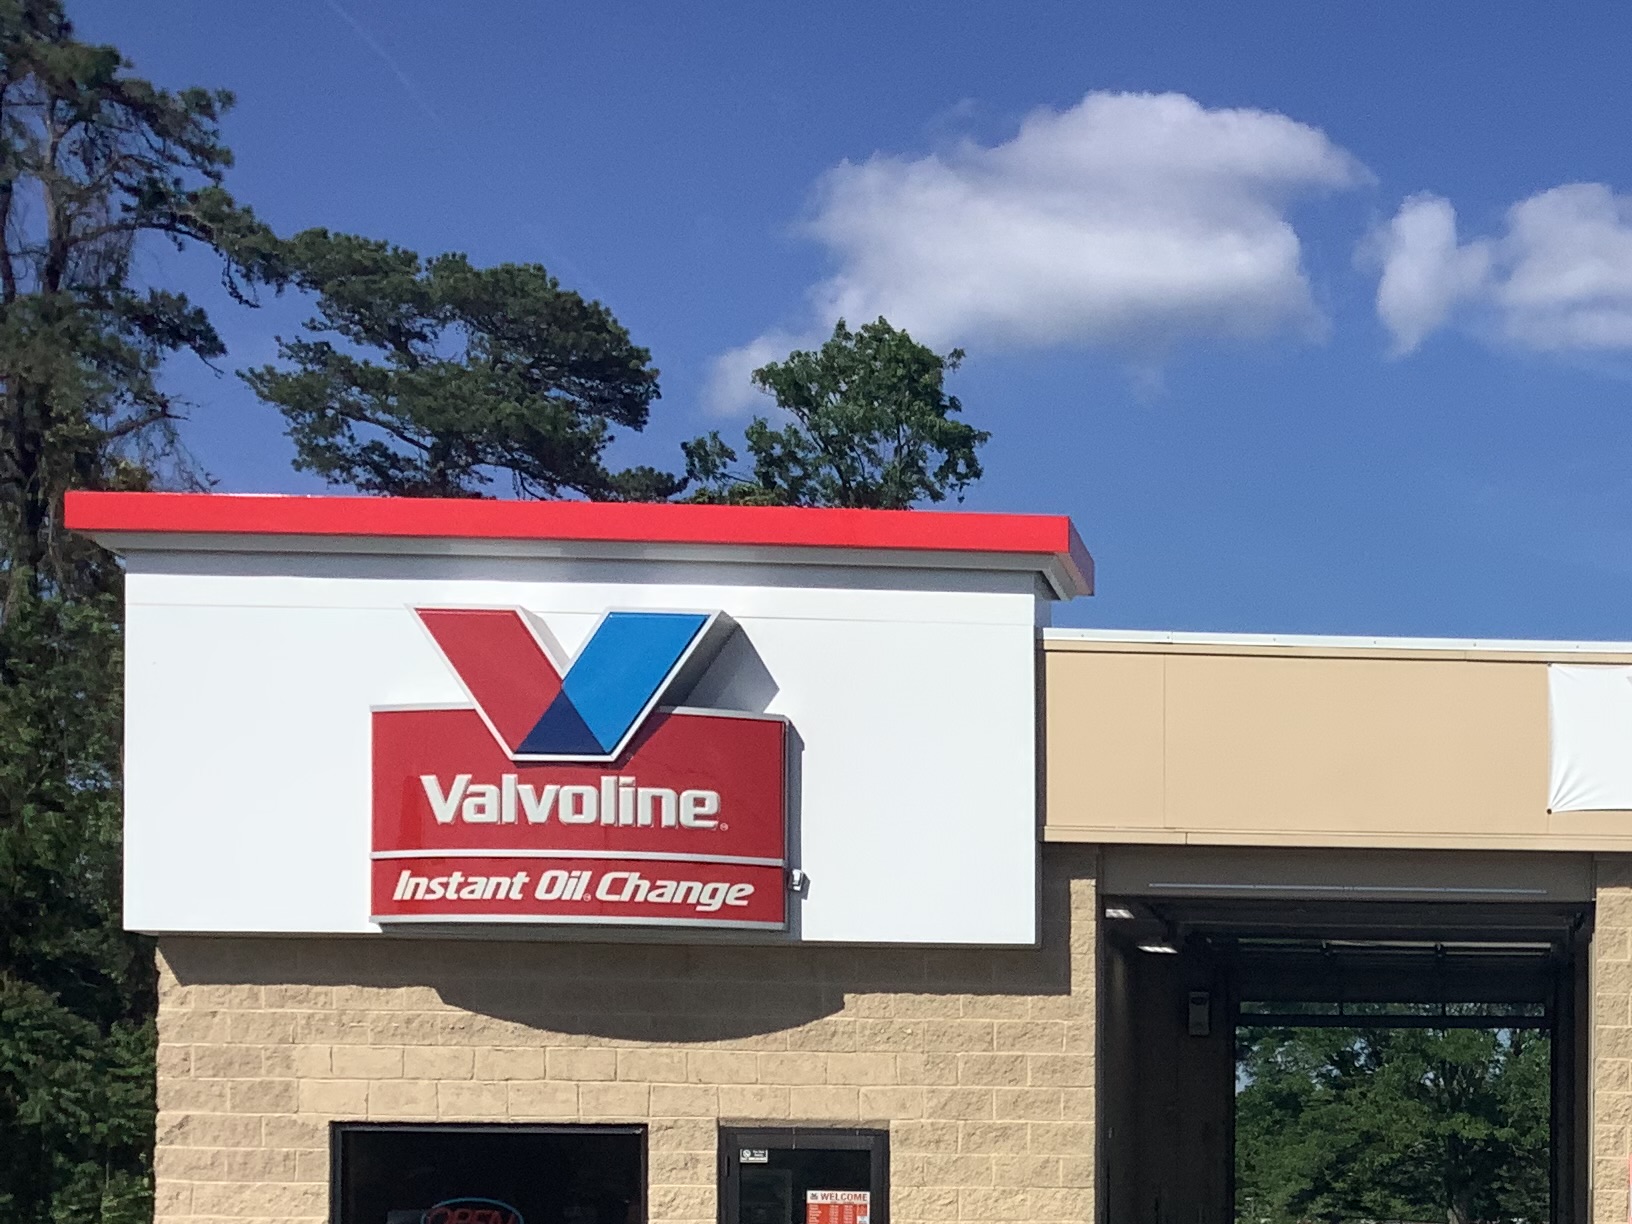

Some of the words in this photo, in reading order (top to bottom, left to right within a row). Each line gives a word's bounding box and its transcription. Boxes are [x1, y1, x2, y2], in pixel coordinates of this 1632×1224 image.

[419, 773, 722, 830] Valvoline
[392, 869, 532, 902] Instant
[534, 869, 592, 902] Oil
[595, 870, 755, 912] Change
[820, 1192, 868, 1202] WELCOME
